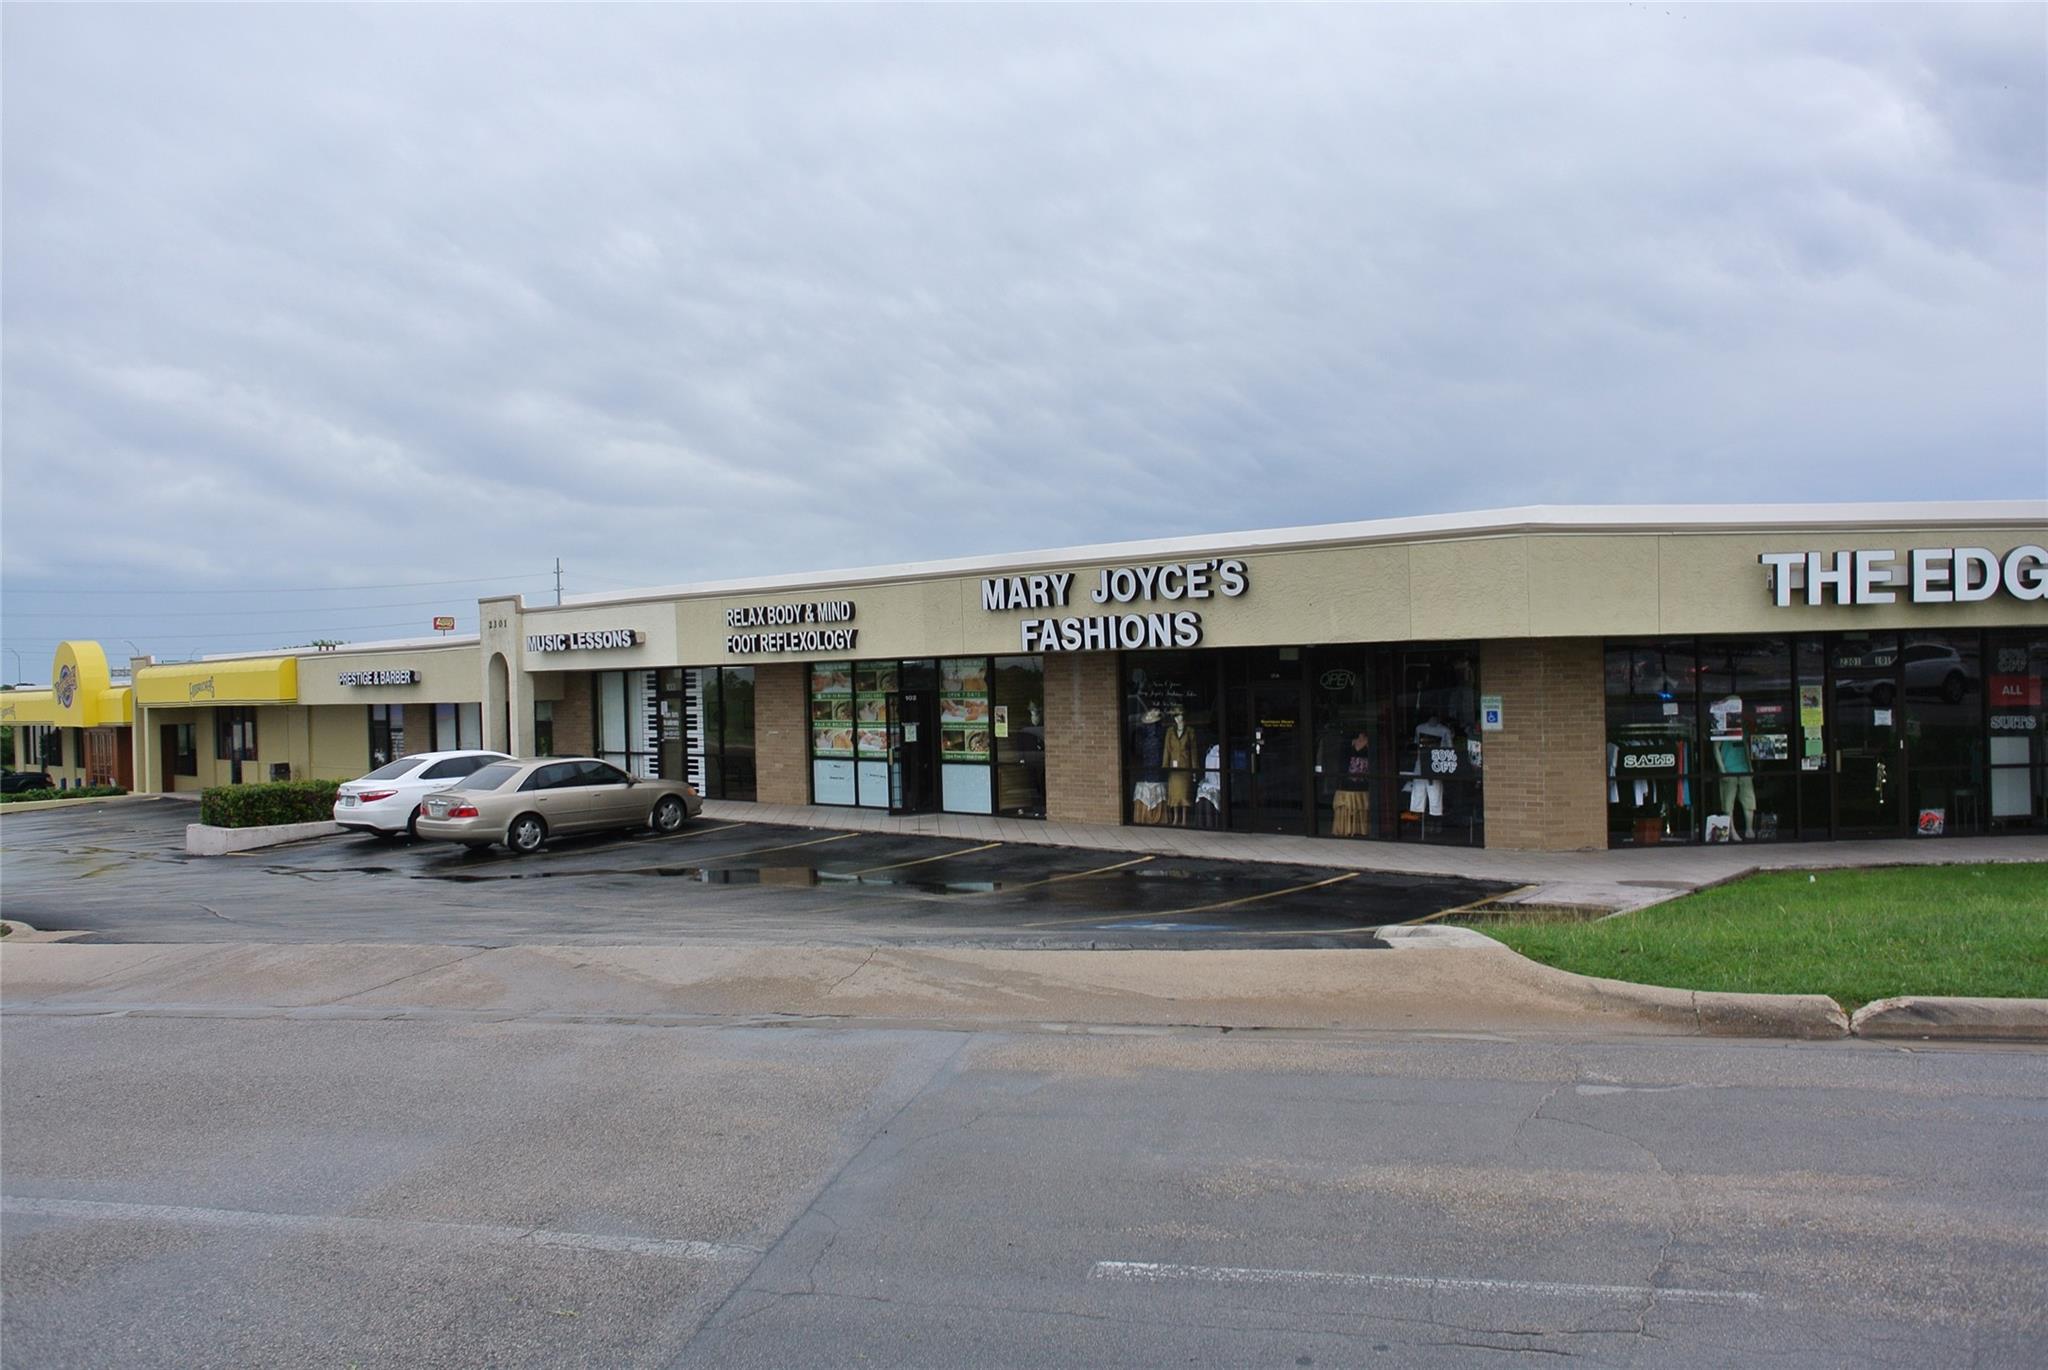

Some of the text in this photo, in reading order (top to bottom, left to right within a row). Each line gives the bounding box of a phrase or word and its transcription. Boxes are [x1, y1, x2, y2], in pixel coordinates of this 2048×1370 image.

[981, 559, 1246, 611] MARY JOYCE'S
[1760, 544, 2048, 608] THE EDG
[726, 601, 851, 627] RELAX BODY & MIND
[526, 630, 632, 652] MUSIC LESSONS
[726, 629, 853, 653] FOOT REFLEXOLOGY
[1021, 611, 1199, 652] FASHIONS
[338, 670, 411, 686] PRESTIGE & BARBER
[1320, 669, 1357, 690] OPEN
[2002, 684, 2024, 696] ALL
[1990, 715, 2037, 729] SUITS
[1431, 749, 1458, 762] 50%
[1624, 753, 1676, 768] SALE
[1431, 761, 1458, 773] OFF
